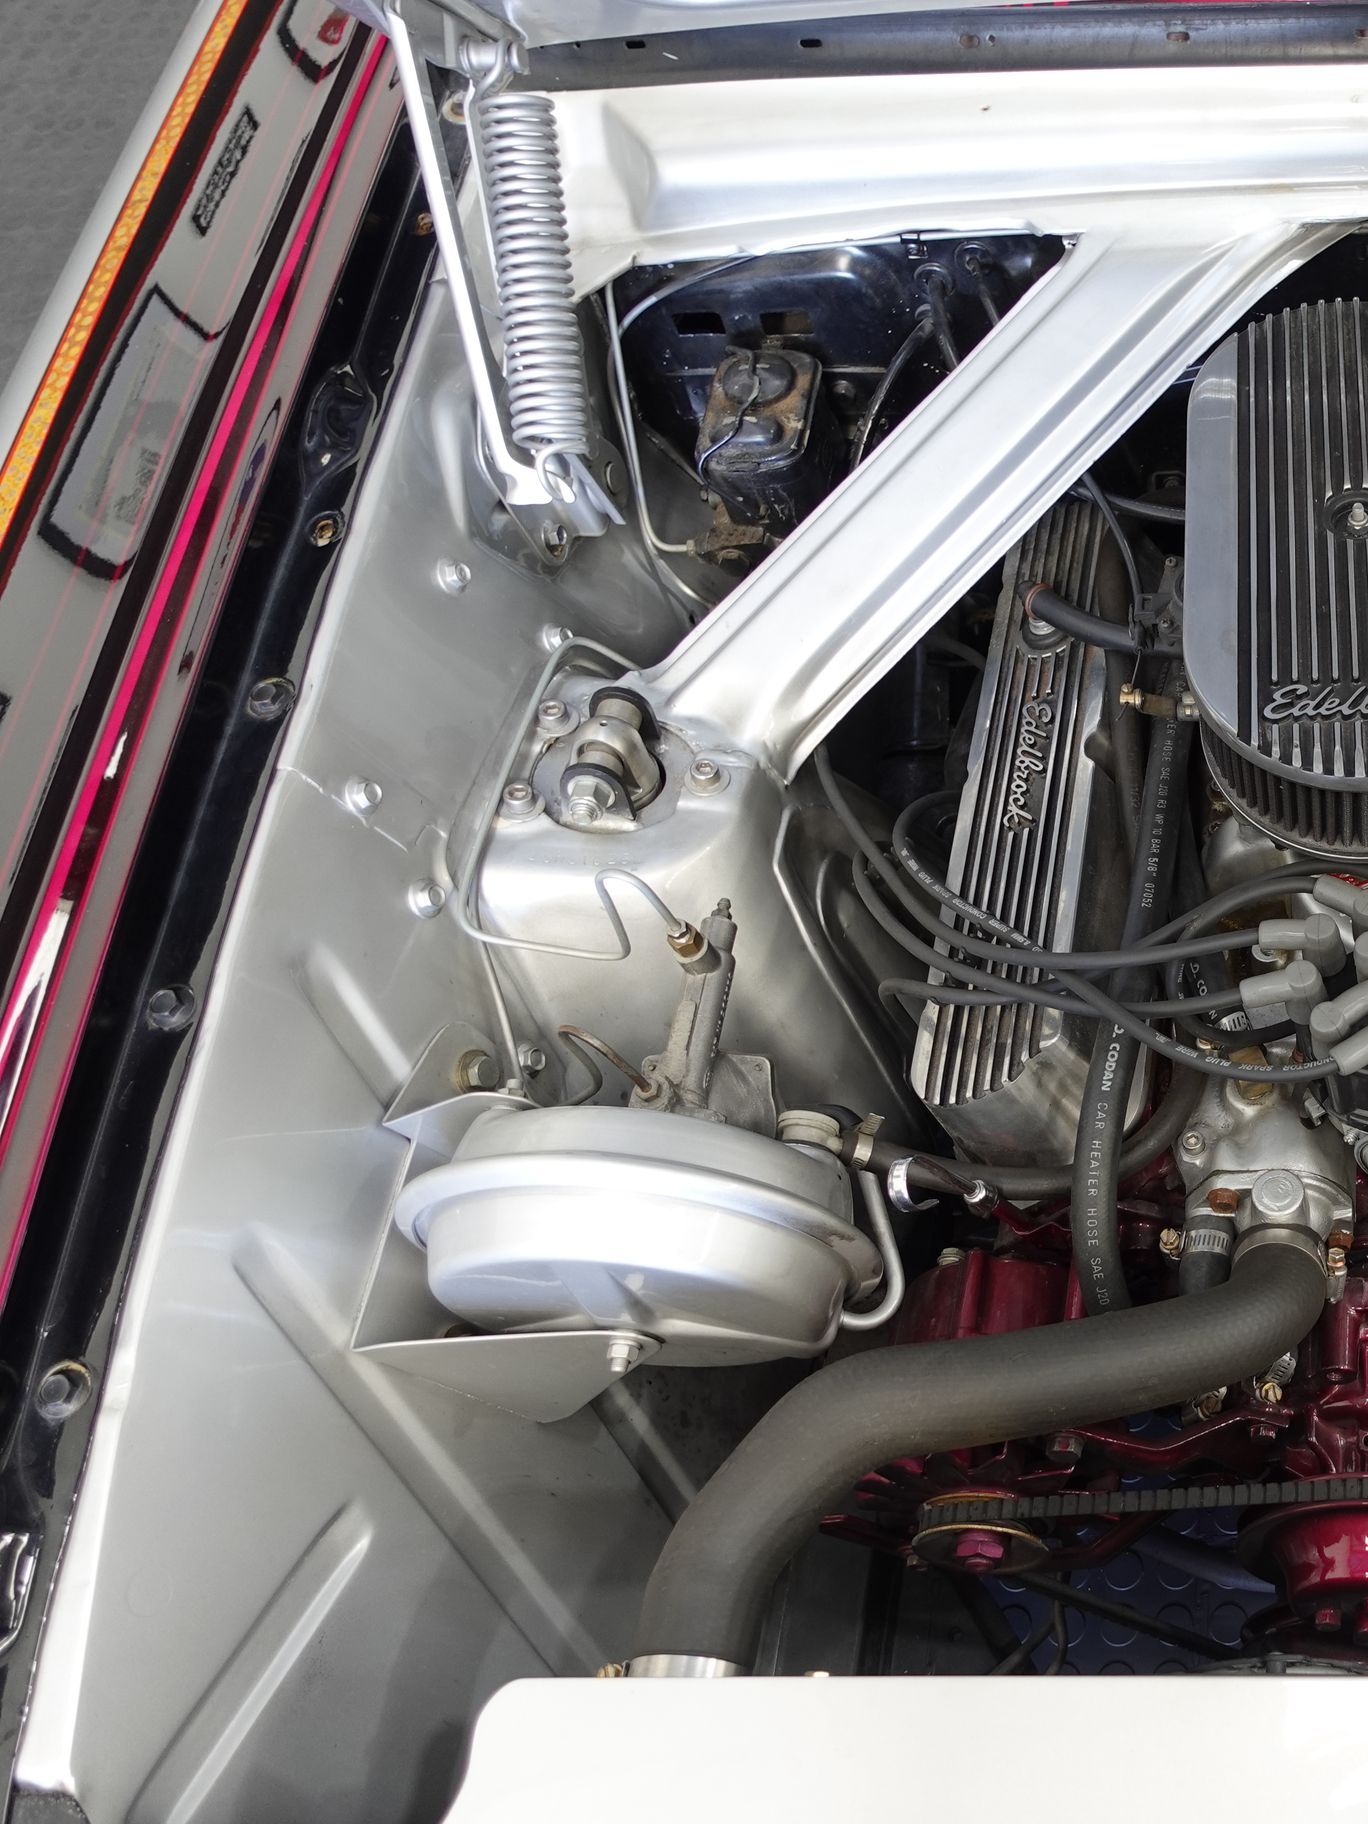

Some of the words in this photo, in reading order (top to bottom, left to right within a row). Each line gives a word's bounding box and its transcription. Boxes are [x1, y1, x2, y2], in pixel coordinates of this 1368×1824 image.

[1162, 740, 1173, 762] HOSE
[1003, 702, 1052, 827] Edelbrock
[1160, 767, 1171, 781] SAE
[1156, 800, 1167, 809] R3
[1150, 838, 1161, 853] BAR
[1141, 882, 1155, 908] 07052
[1101, 1043, 1121, 1091] CODAN
[1205, 1056, 1231, 1068] PLUG
[1238, 1063, 1273, 1072] SPARK
[1094, 1102, 1109, 1129] CAR
[1087, 1140, 1102, 1196] HEATER
[1087, 1208, 1099, 1247] HOSE
[1090, 1257, 1104, 1281] SAE
[1096, 1287, 1110, 1306] J20
